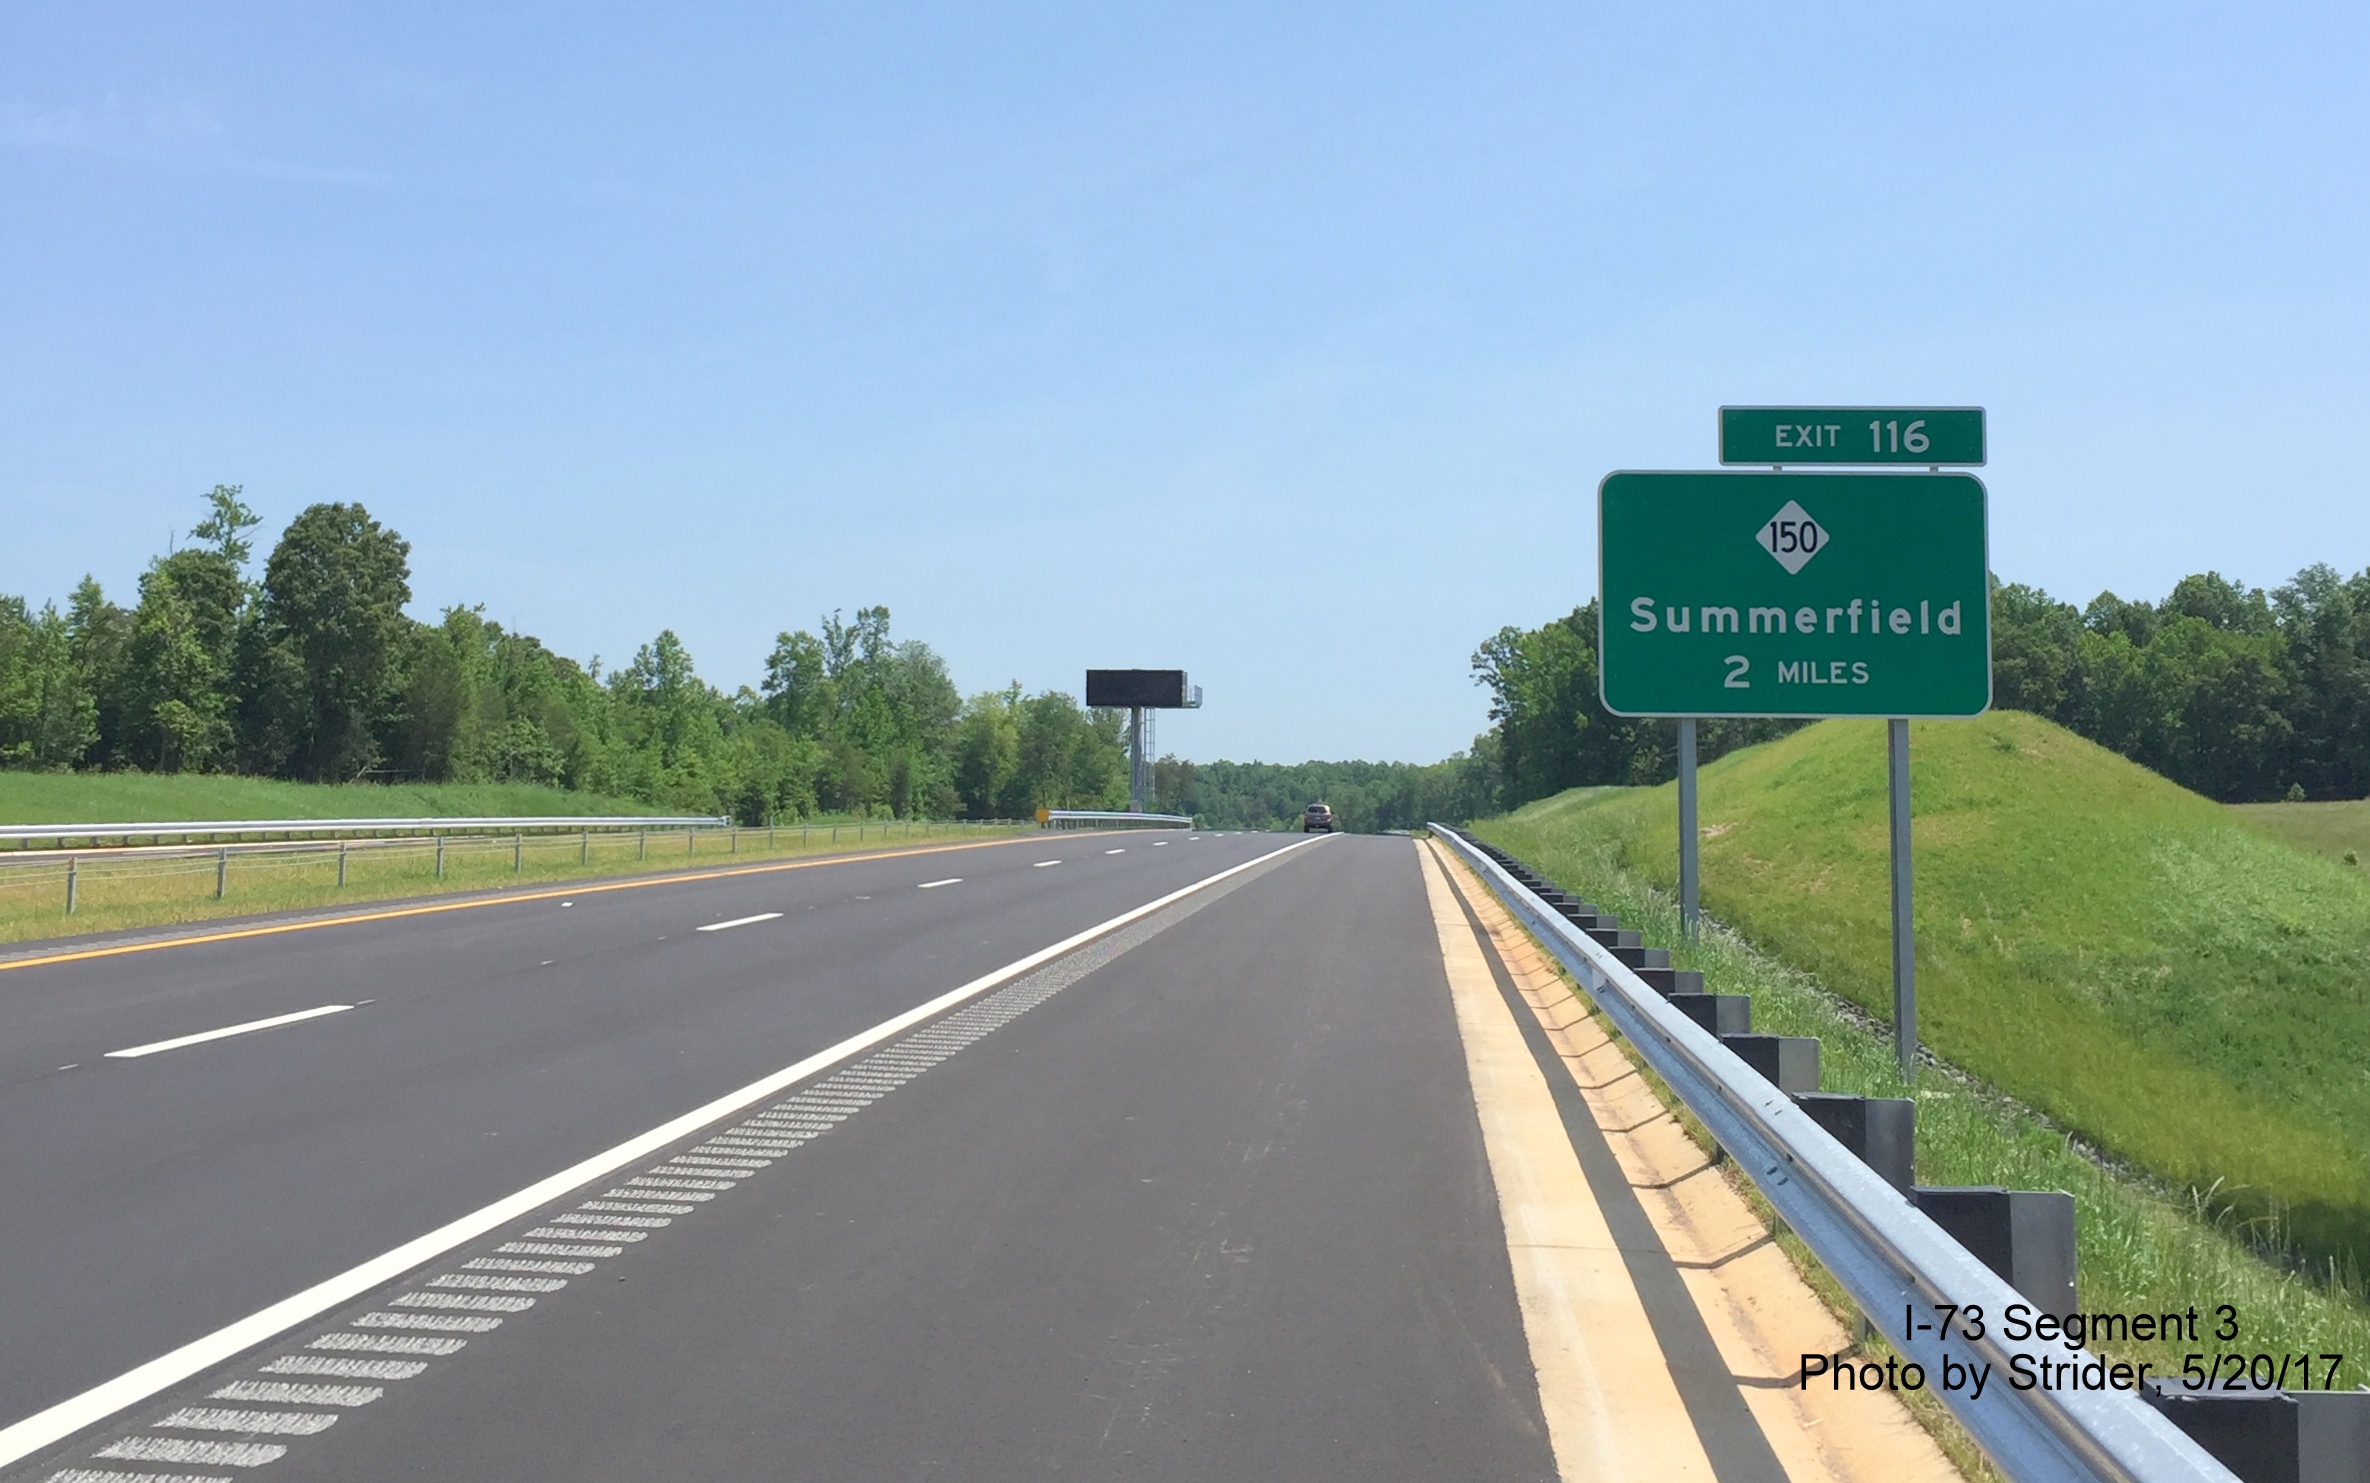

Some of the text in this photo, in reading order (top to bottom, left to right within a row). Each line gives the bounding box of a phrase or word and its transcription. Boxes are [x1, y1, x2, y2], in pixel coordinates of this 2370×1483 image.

[1775, 420, 1930, 453] EXIT 116
[1769, 520, 1818, 553] 150
[1629, 596, 1962, 635] Summerfield
[1723, 655, 1869, 688] 2 MILES
